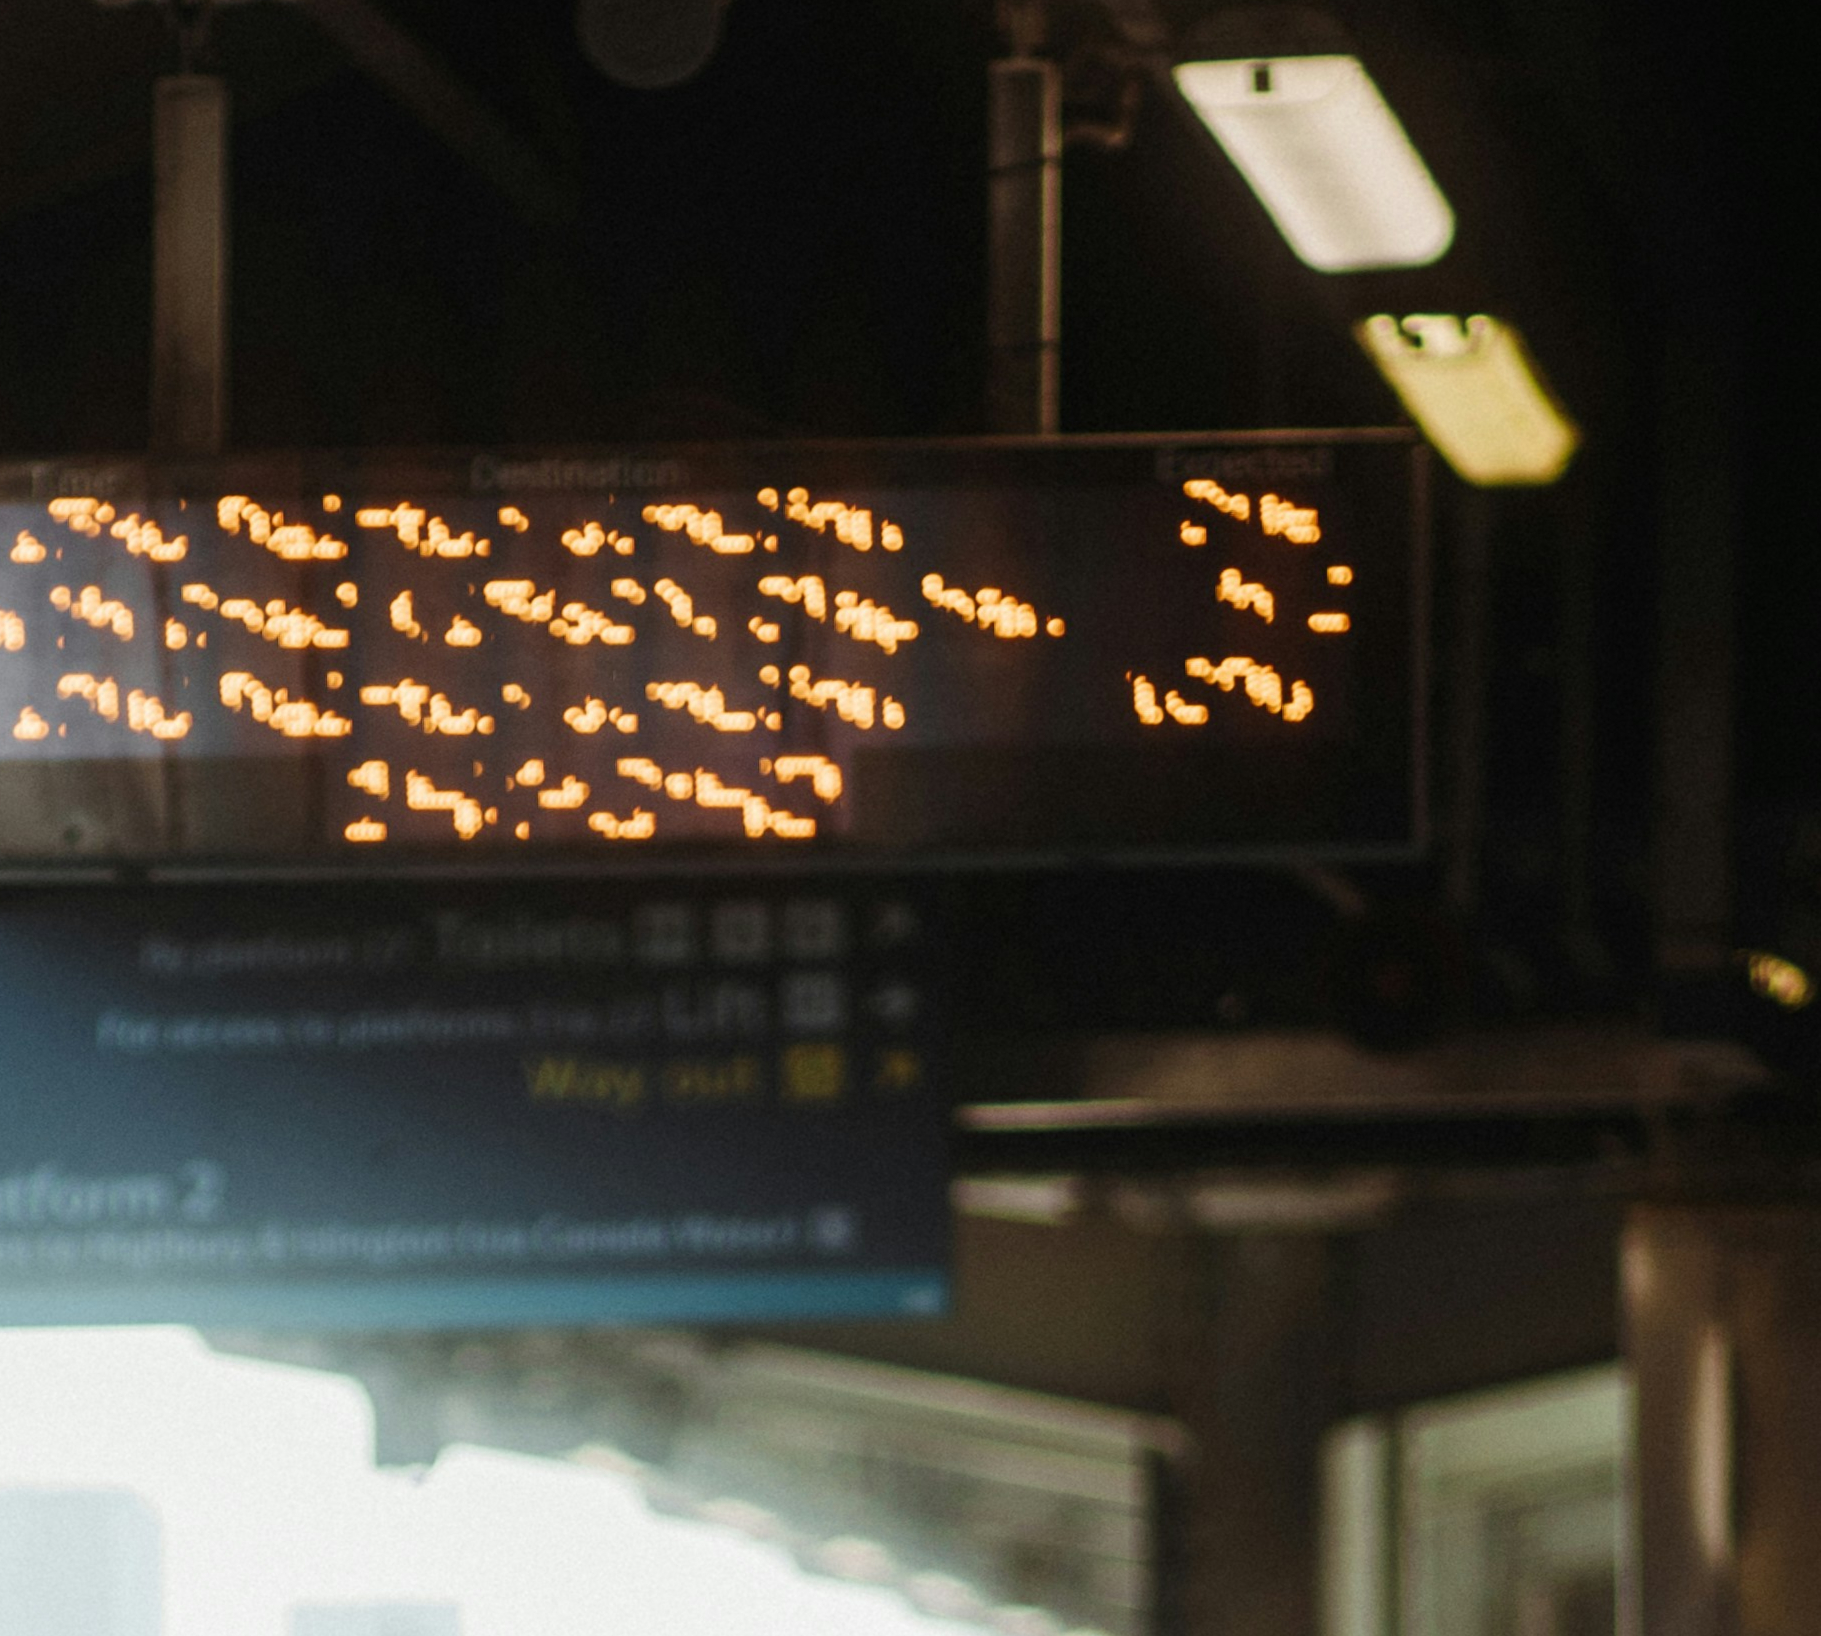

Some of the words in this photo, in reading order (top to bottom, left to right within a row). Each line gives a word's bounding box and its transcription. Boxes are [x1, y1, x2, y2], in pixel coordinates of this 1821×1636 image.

[470, 454, 682, 488] Destination
[426, 909, 621, 964] Toilets
[520, 1056, 646, 1104] Way
[663, 1054, 763, 1096] out
[178, 1157, 227, 1221] 2
